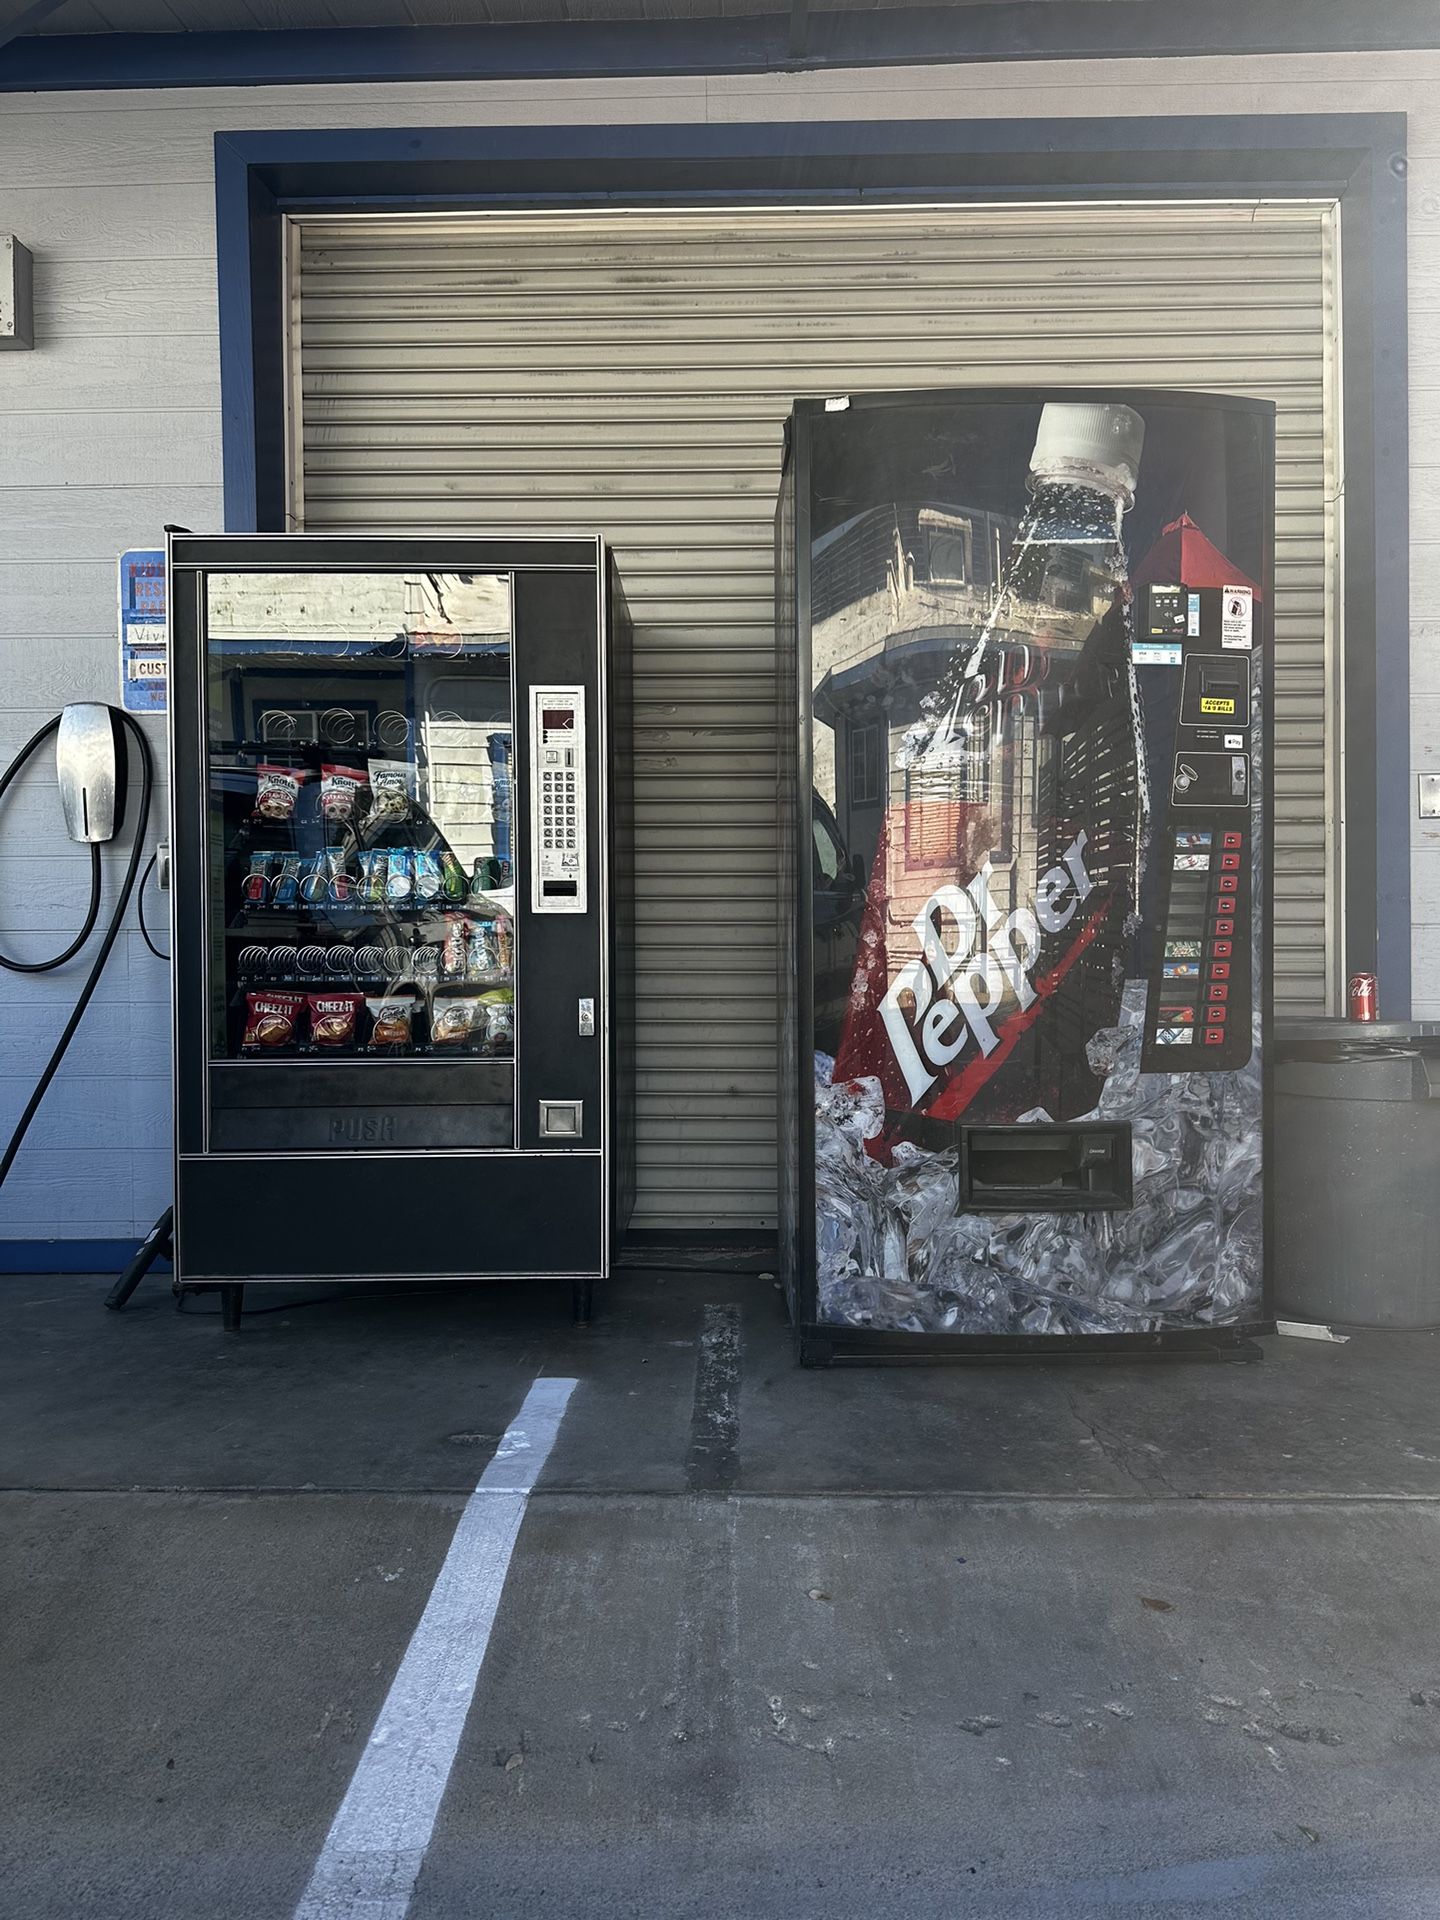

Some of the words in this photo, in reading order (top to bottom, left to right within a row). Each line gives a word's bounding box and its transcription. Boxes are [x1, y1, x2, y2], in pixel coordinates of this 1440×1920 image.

[331, 777, 357, 788] Knott'
[373, 770, 406, 782] Famous
[911, 859, 1004, 991] Dr
[876, 828, 1096, 1109] Pepper
[328, 1116, 398, 1142] PUSH
